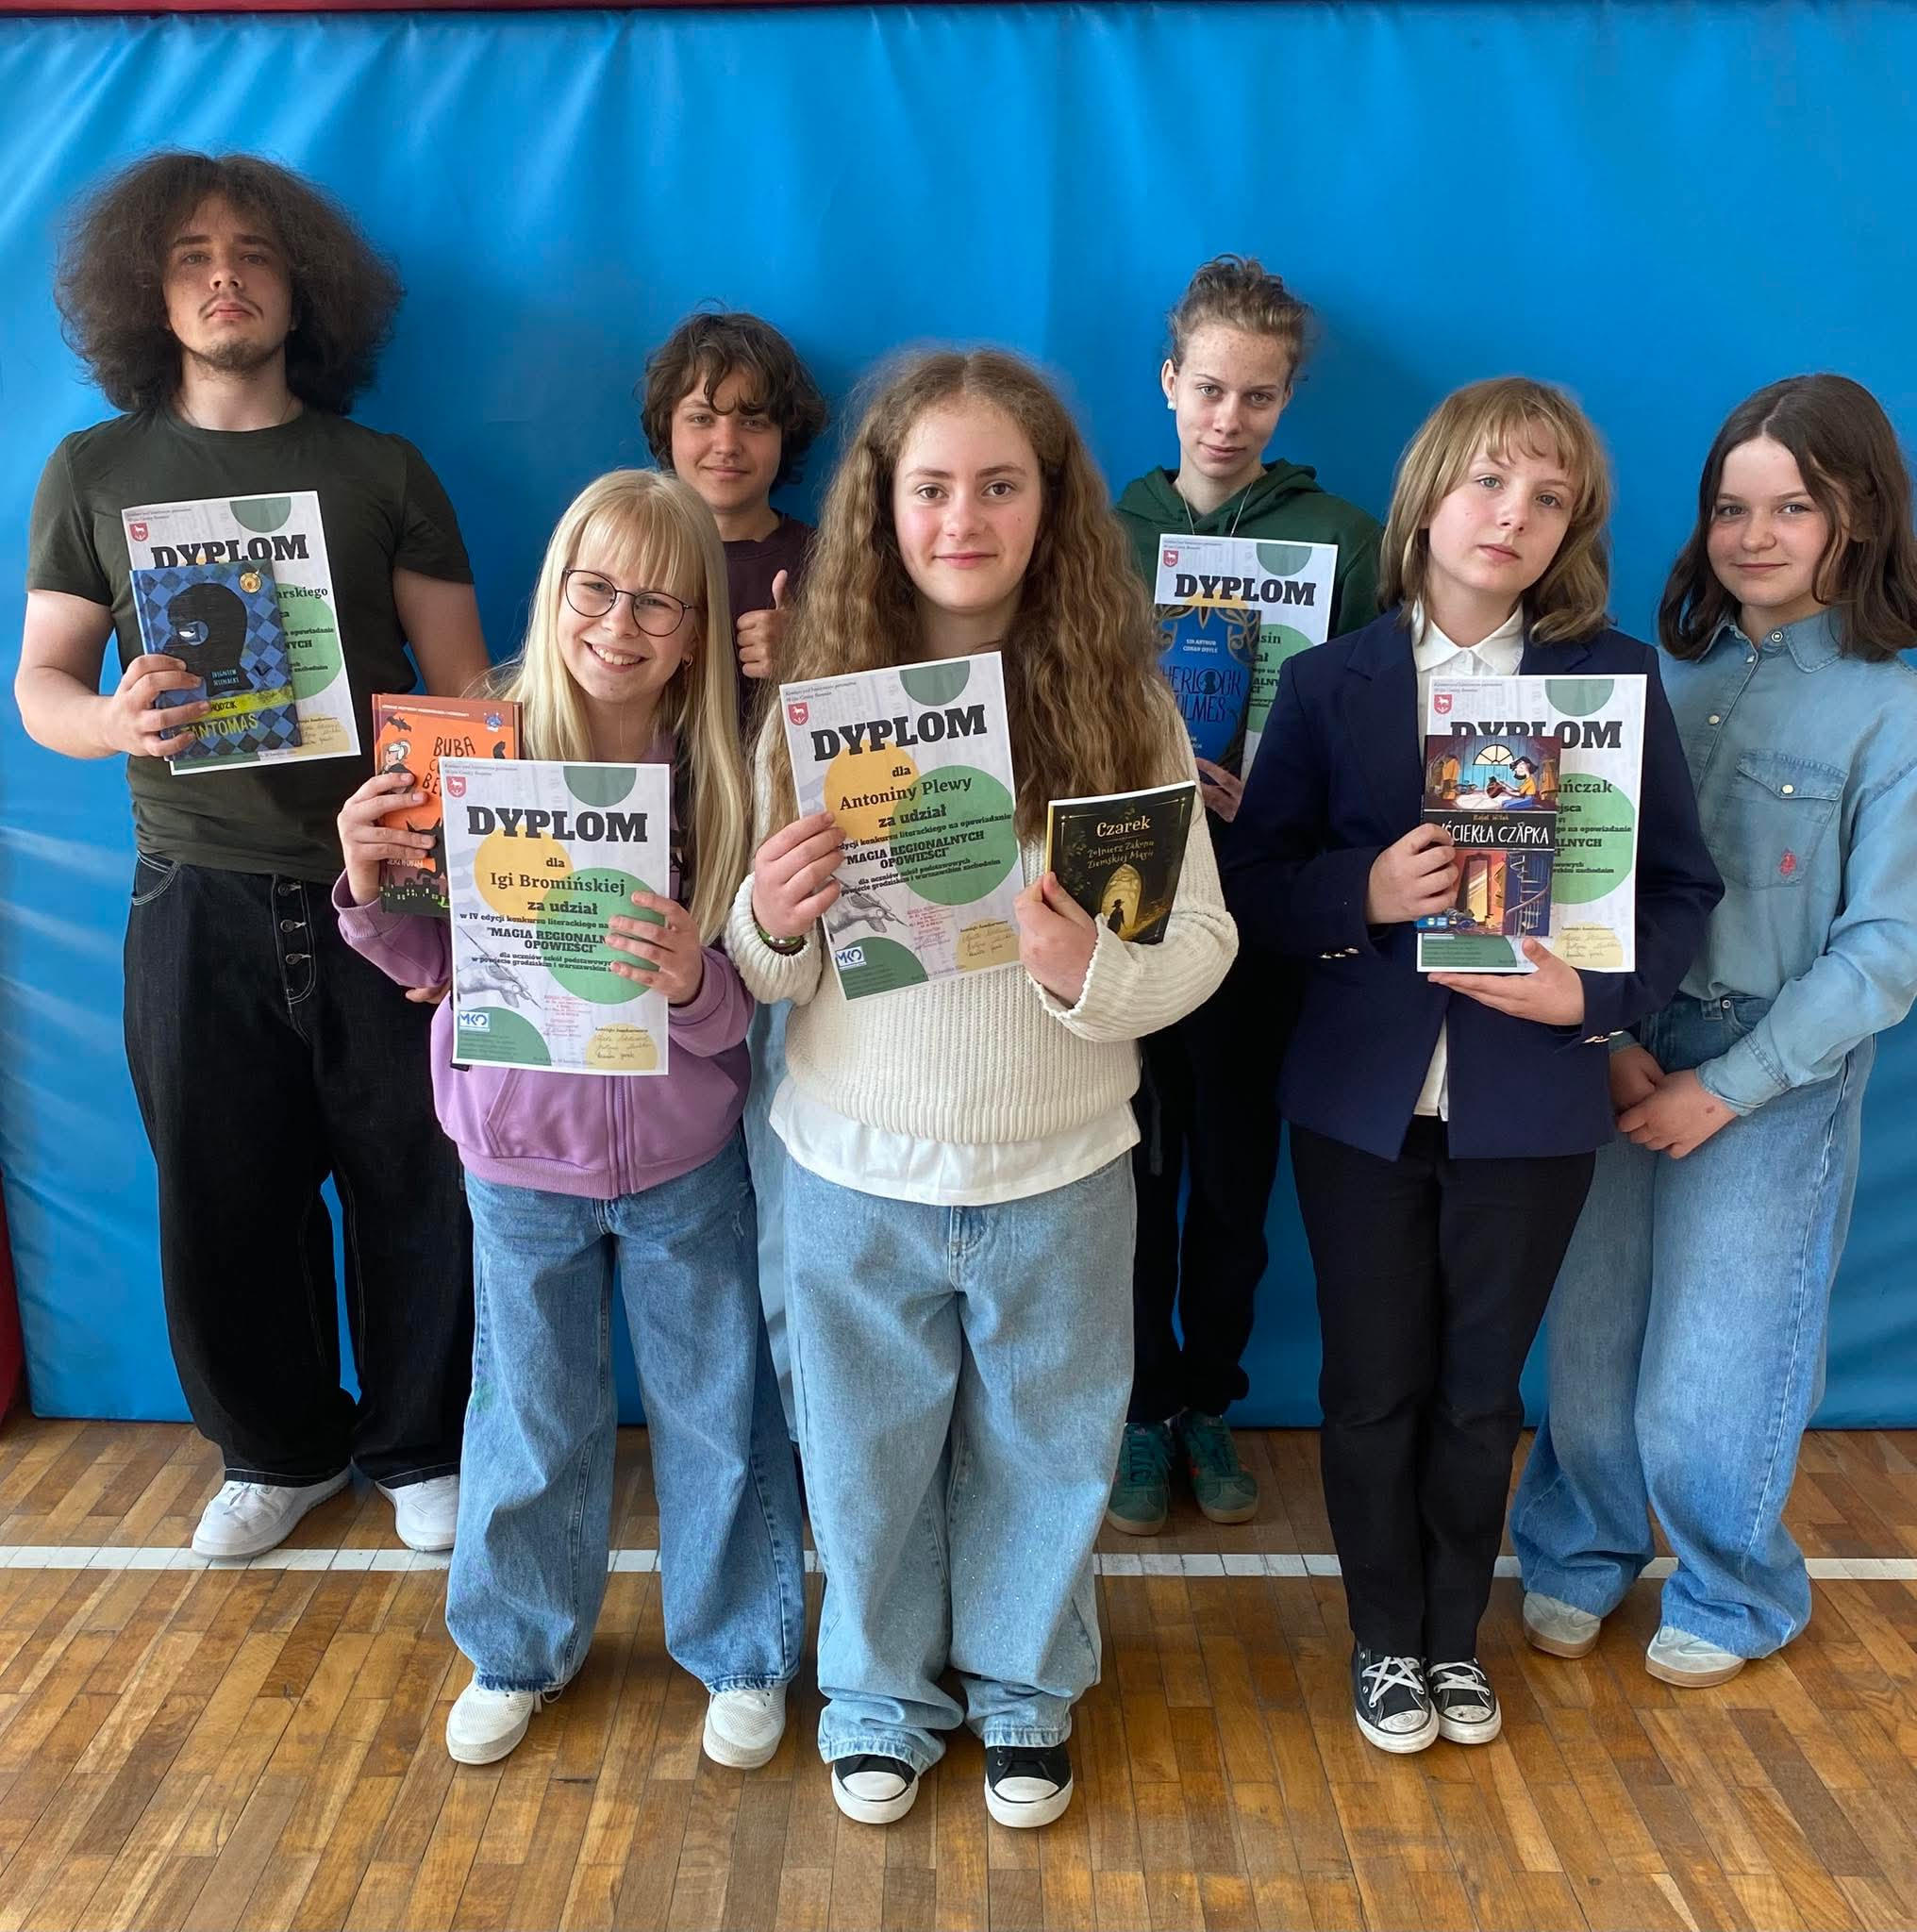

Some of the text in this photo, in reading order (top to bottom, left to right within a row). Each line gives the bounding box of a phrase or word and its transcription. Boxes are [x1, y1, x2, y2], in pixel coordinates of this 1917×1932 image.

[151, 534, 309, 569] DYPLOM
[1175, 573, 1317, 607] DYPLOM
[1159, 665, 1242, 697] HERLOCK
[1176, 694, 1226, 723] OLMES
[181, 713, 258, 741] ANTOMAS
[810, 704, 988, 761] DYPLOM
[434, 736, 475, 758] BUBA
[892, 766, 911, 777] dla
[840, 777, 973, 810] Antoniny Plewy
[466, 806, 648, 842] DYPLOM
[878, 804, 947, 828] za udział
[1096, 815, 1151, 837] Czarek
[859, 834, 898, 846] konkursu
[900, 824, 947, 838] literackiego
[960, 813, 1012, 827] opowiadanie
[1442, 820, 1550, 845] ŚCIEKŁA CZAPKA
[1580, 824, 1632, 834] opowiadanie
[890, 830, 985, 857] REGIONALNYCH
[546, 858, 565, 868] dla
[491, 872, 625, 896] Igi Bromińskiej
[527, 900, 598, 915] za udział
[481, 913, 505, 923] edycji
[507, 915, 546, 924] konkursu
[548, 918, 596, 928] literackiego
[536, 930, 606, 943] REGIONALN
[564, 957, 611, 966] podstawowy
